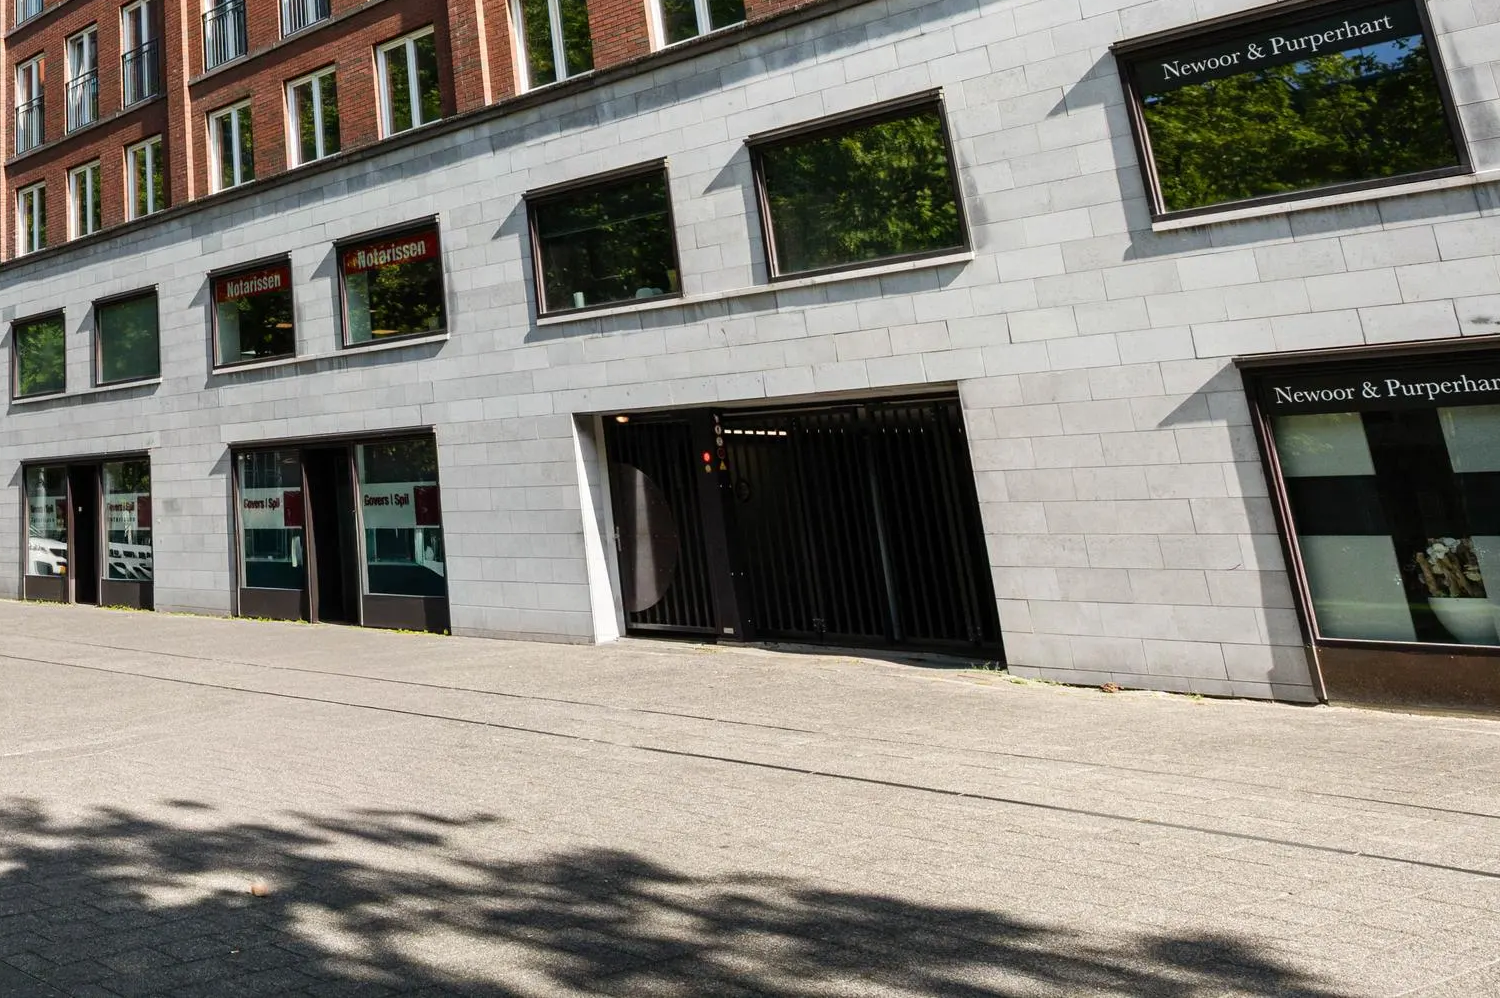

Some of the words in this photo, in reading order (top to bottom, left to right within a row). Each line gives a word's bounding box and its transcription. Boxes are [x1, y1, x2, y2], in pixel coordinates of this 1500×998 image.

[1161, 50, 1241, 80] Newoor
[1247, 43, 1267, 61] &
[1269, 14, 1394, 55] Purperhart
[357, 240, 426, 269] Notarissen
[227, 274, 281, 298] Notarissen
[1273, 386, 1356, 404] Newoor
[1362, 381, 1381, 399] &
[364, 494, 390, 506] Govers
